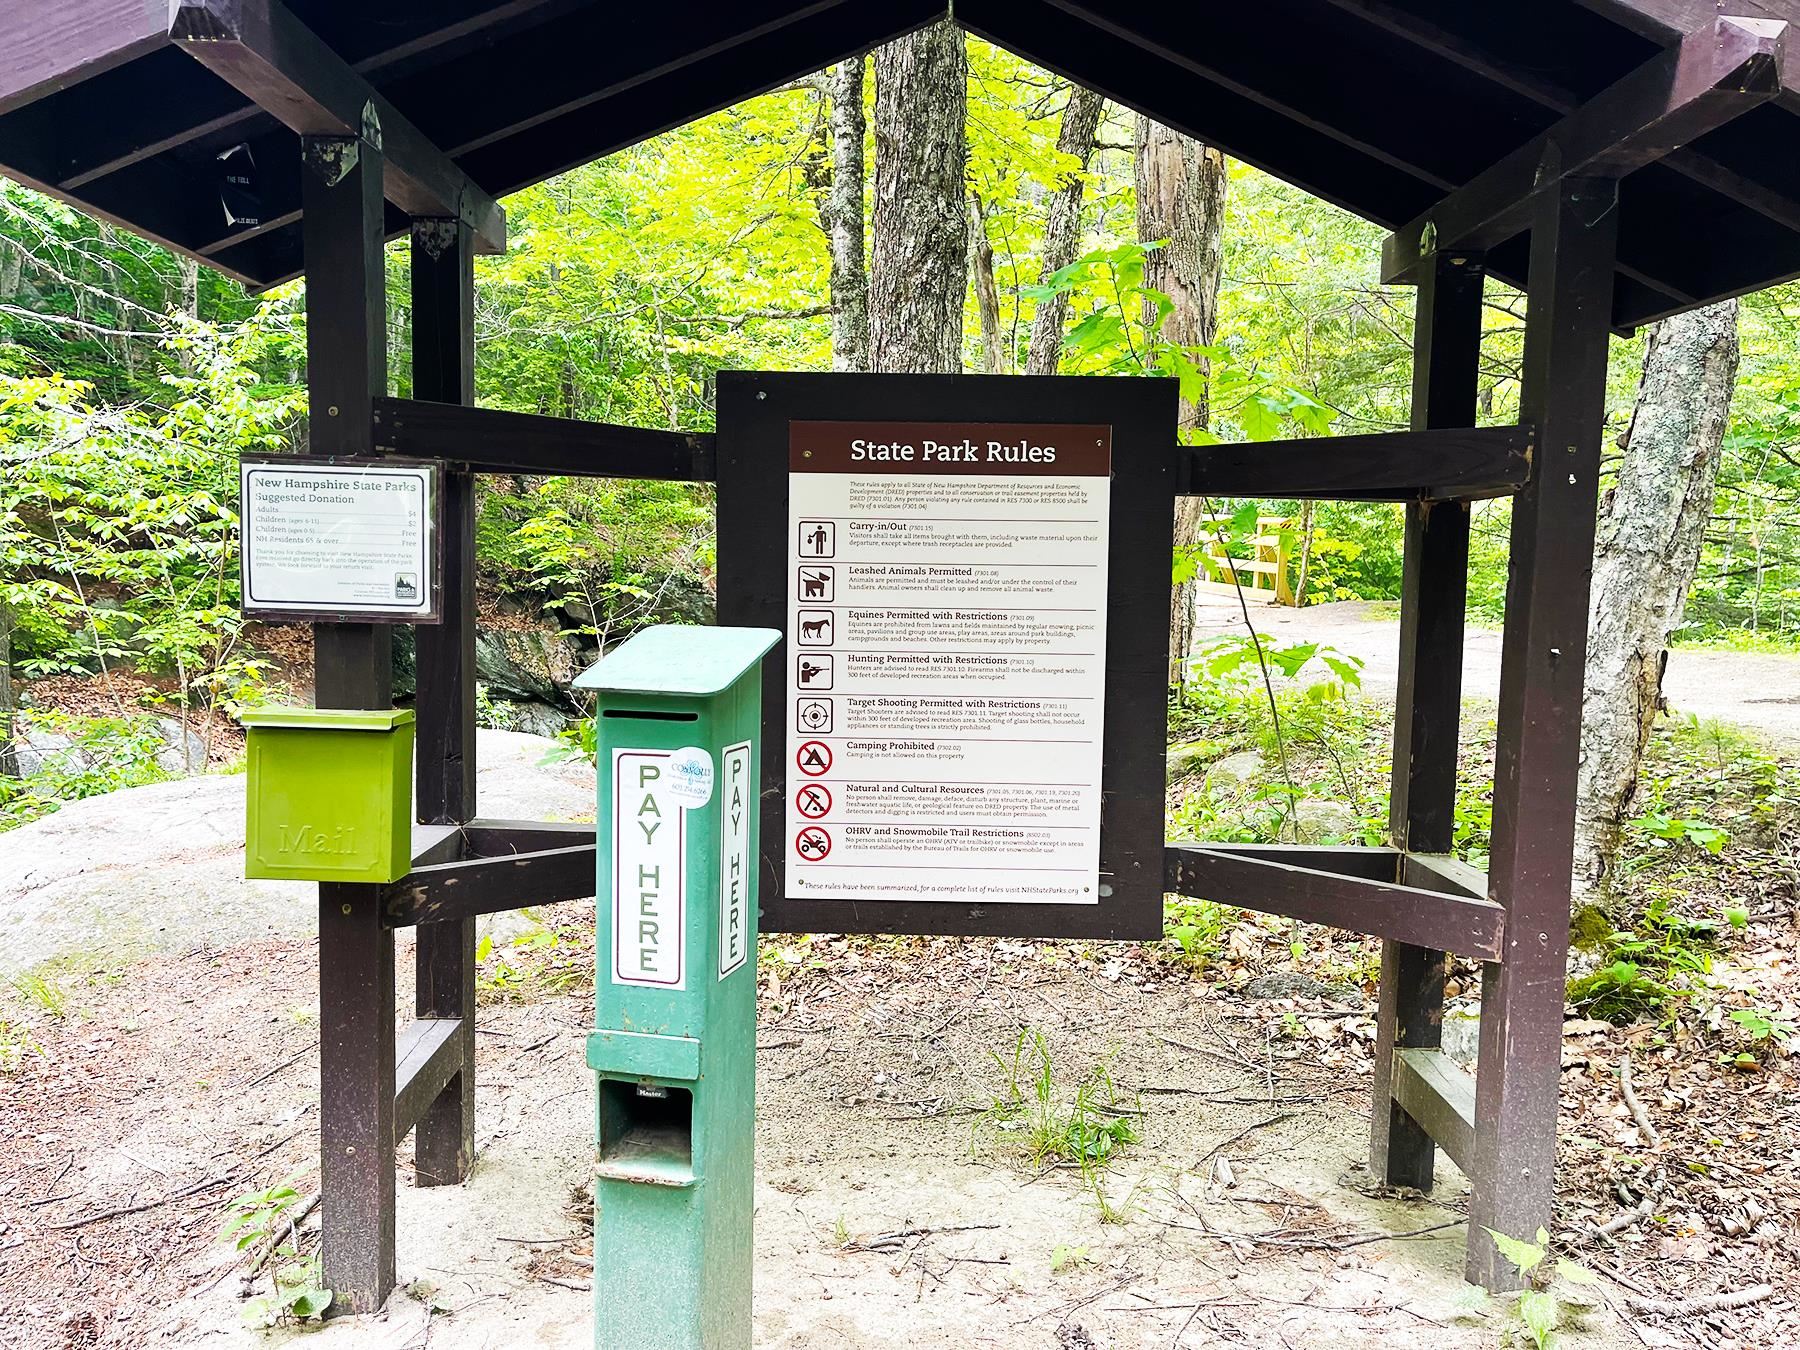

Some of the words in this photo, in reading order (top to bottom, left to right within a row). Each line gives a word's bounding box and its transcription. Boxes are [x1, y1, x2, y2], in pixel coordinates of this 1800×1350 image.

[851, 440, 914, 461] State
[922, 439, 978, 461] Park
[986, 440, 1055, 462] Rules
[254, 477, 281, 488] New
[284, 478, 349, 492] Hampshire
[352, 480, 381, 491] State
[385, 480, 416, 492] Parks
[255, 492, 306, 504] Suggested
[308, 494, 354, 503] Donation
[255, 515, 286, 523] Children
[255, 525, 286, 533] Children
[849, 521, 906, 530] Carry-in/Out
[269, 535, 303, 543] Residents
[849, 566, 886, 574] Leashed
[888, 566, 926, 575] Animals
[928, 567, 971, 575] Permitted
[848, 610, 884, 620] Equines
[886, 610, 929, 619] Permitted
[932, 611, 952, 619] with
[955, 612, 1007, 620] Restrictions
[847, 654, 884, 664] Hunting
[886, 655, 929, 663] Permitted
[932, 655, 952, 663] with
[955, 656, 1007, 664] Restrictions
[847, 698, 875, 707] Target
[877, 698, 917, 708] Shooting
[919, 699, 962, 707] Permitted
[965, 699, 985, 707] with
[988, 700, 1040, 708] Restrictions
[846, 741, 887, 750] Camping
[889, 741, 934, 750] Prohibited
[846, 784, 879, 792] Natural
[881, 784, 898, 792] and
[901, 784, 937, 793] Cultural
[939, 785, 984, 794] Resources
[731, 759, 741, 836] PAY
[637, 764, 662, 845] PAY
[845, 826, 871, 834] OHRV
[874, 827, 890, 835] and
[893, 827, 948, 836] Snowmobile
[949, 828, 969, 836] Trail
[972, 829, 1024, 837] Restrictions
[278, 824, 358, 856] Mail
[919, 884, 929, 892] for
[979, 886, 986, 894] of
[729, 852, 740, 959] HERE
[638, 864, 660, 973] HERE
